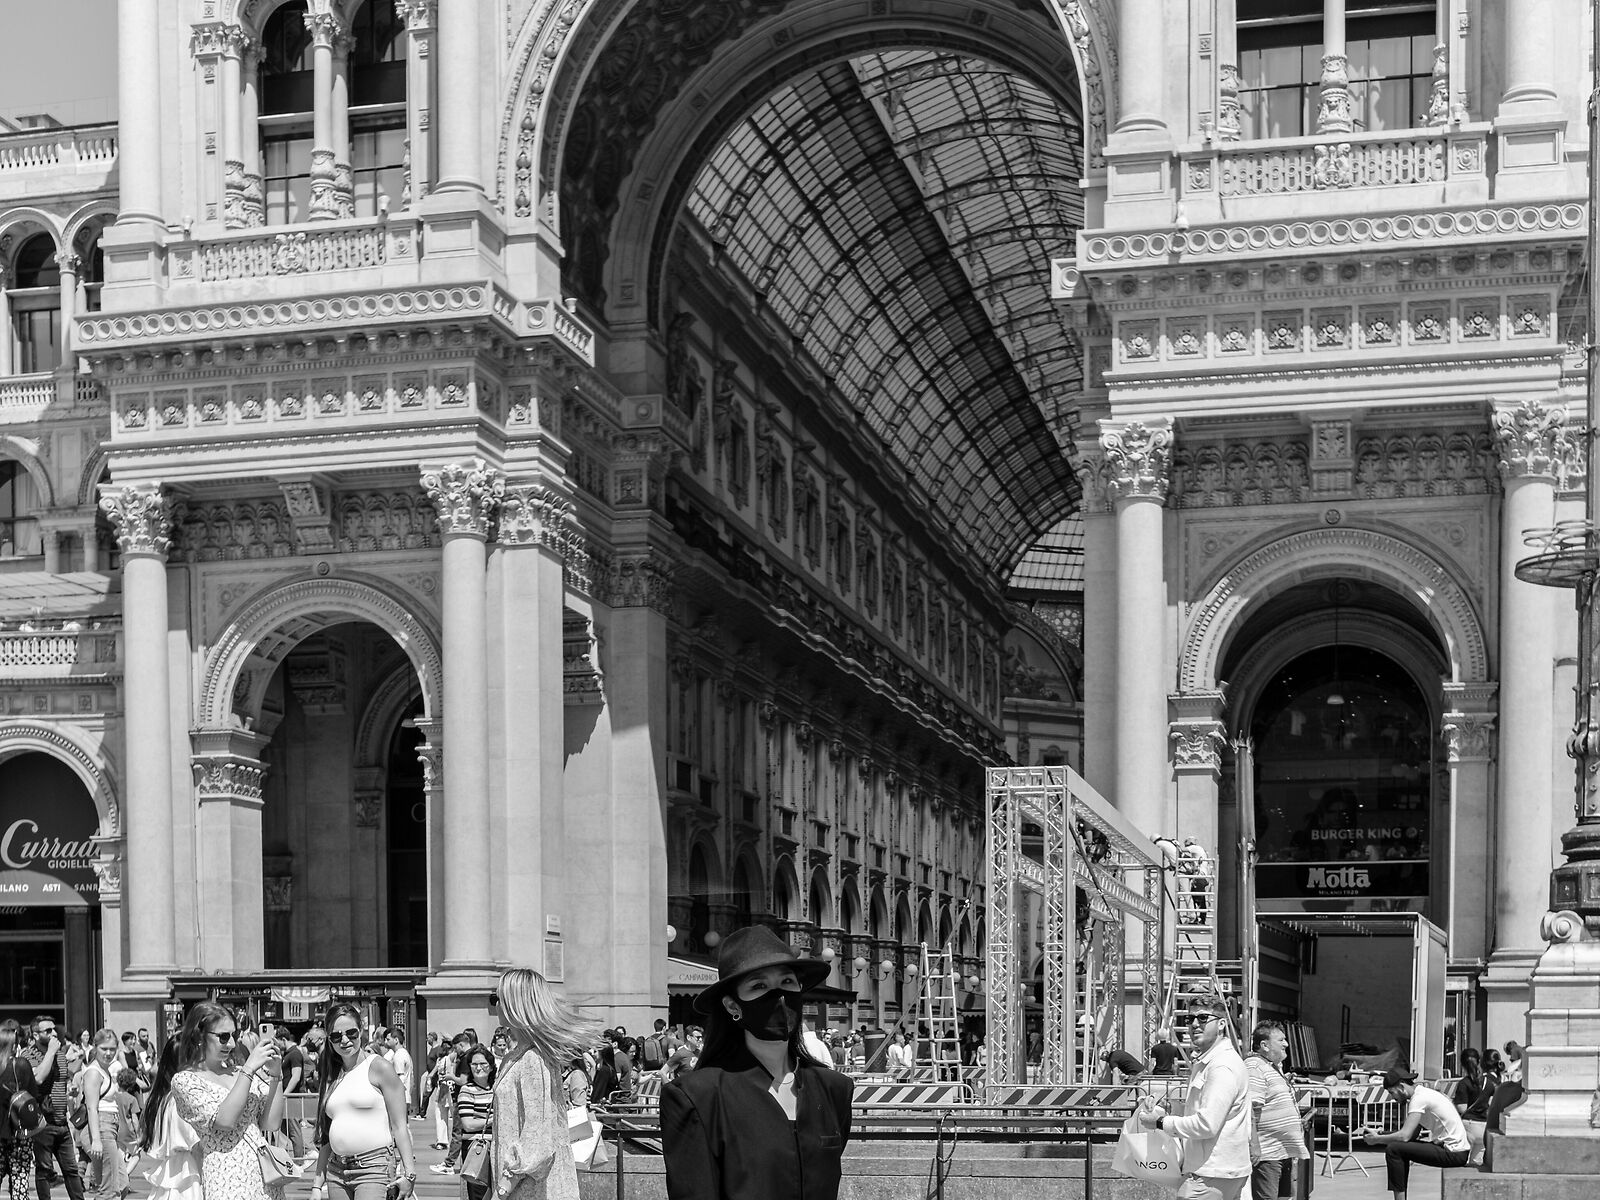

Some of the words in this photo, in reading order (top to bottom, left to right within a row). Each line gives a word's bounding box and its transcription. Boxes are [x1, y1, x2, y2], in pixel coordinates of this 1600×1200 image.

[1311, 829, 1364, 840] BURGER
[1367, 828, 1402, 839] KING
[1, 819, 100, 869] Currad
[1306, 867, 1371, 888] Motta
[0, 883, 29, 893] ILANO
[42, 883, 60, 892] ASTI
[1135, 1160, 1168, 1170] NGO
